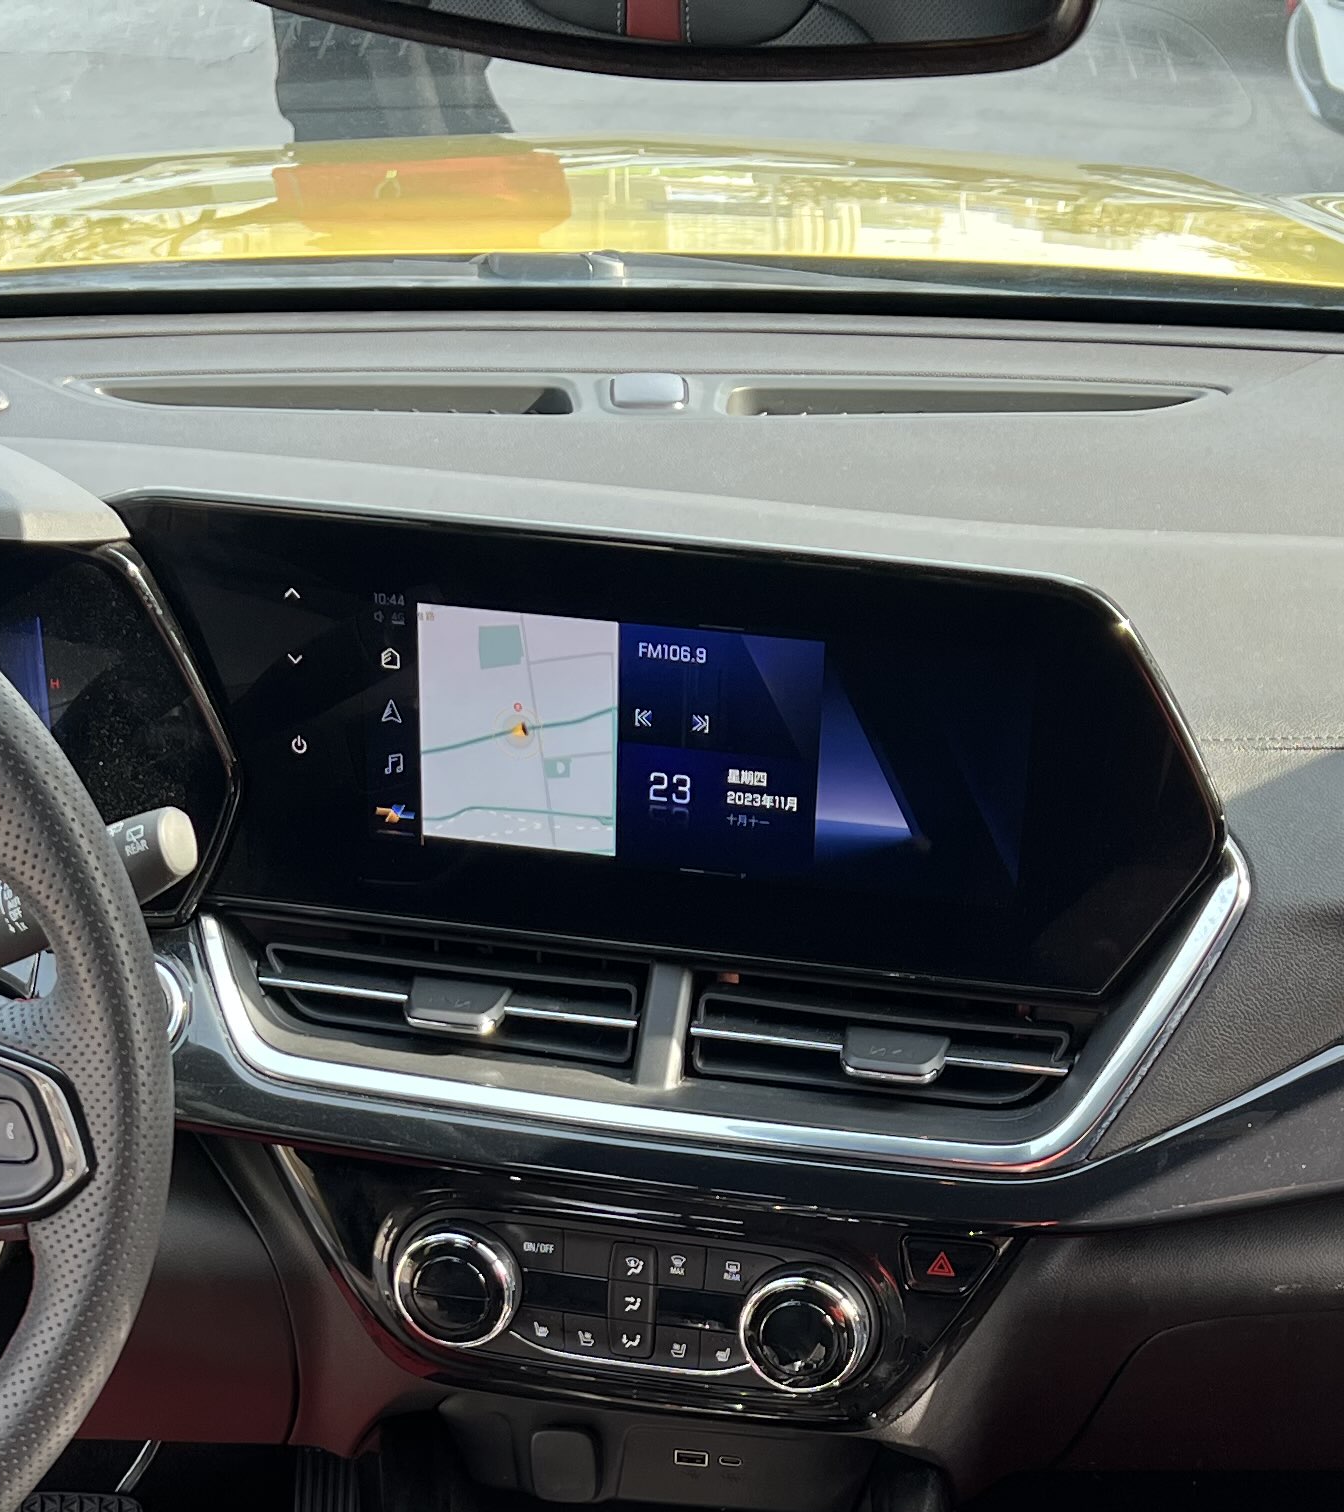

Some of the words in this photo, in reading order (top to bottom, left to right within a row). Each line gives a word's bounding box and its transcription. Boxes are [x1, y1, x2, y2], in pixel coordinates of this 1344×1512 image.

[374, 592, 405, 606] 10:44
[638, 642, 707, 664] FM106.9
[50, 678, 60, 689] H
[727, 768, 768, 787] 星期四
[649, 771, 691, 805] 23
[726, 790, 798, 812] 2023年11月
[726, 813, 770, 828] 十月十一
[125, 839, 149, 857] REAR
[523, 1241, 555, 1254] ON/OFF
[669, 1266, 685, 1276] MAX
[723, 1271, 741, 1282] REAR
